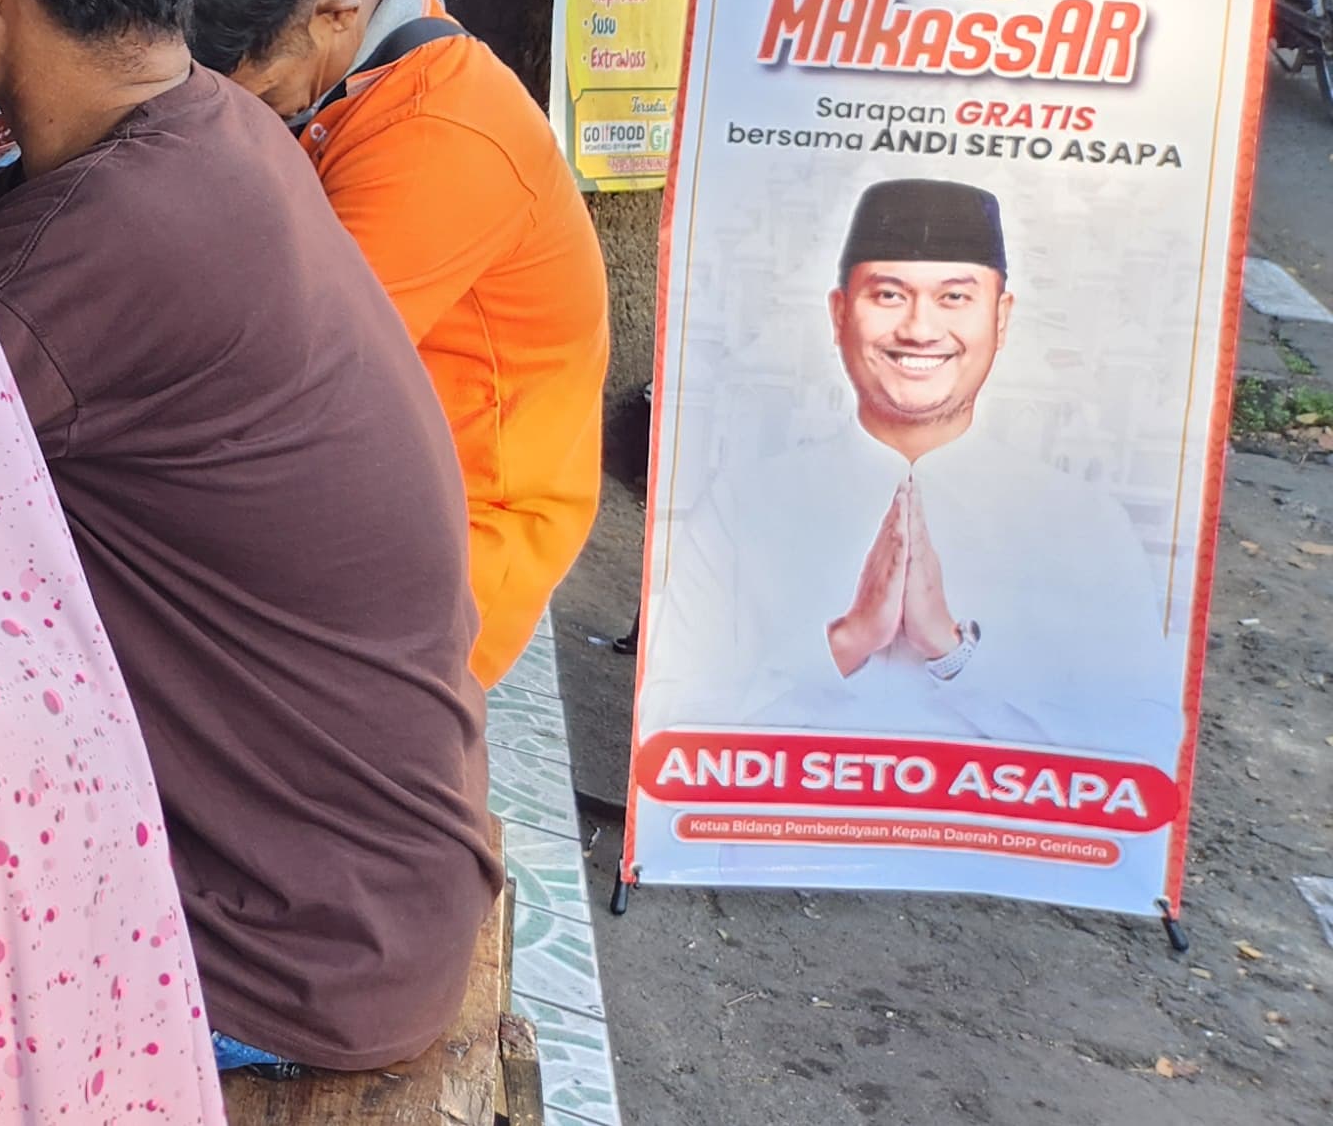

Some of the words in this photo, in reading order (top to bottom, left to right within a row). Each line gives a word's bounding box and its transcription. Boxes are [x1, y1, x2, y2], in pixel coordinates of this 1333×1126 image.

[591, 12, 616, 35] Susu
[816, 96, 946, 126] Sarapan
[955, 100, 1097, 132] GRATIS
[728, 122, 863, 153] bersama
[871, 128, 959, 155] ANDI
[964, 133, 1054, 160] SETO
[1059, 140, 1183, 168] ASAPA
[656, 748, 785, 788] ANDI
[801, 751, 937, 794] SETO
[948, 760, 1148, 819] ASAPA
[690, 819, 730, 834] Ketua
[731, 820, 782, 840] Bidang
[784, 821, 889, 839] Pemberdayaan
[892, 824, 940, 844] Kepala
[943, 827, 998, 845] Daerah
[1001, 833, 1037, 849] DPP
[1040, 837, 1108, 859] Gerindra
